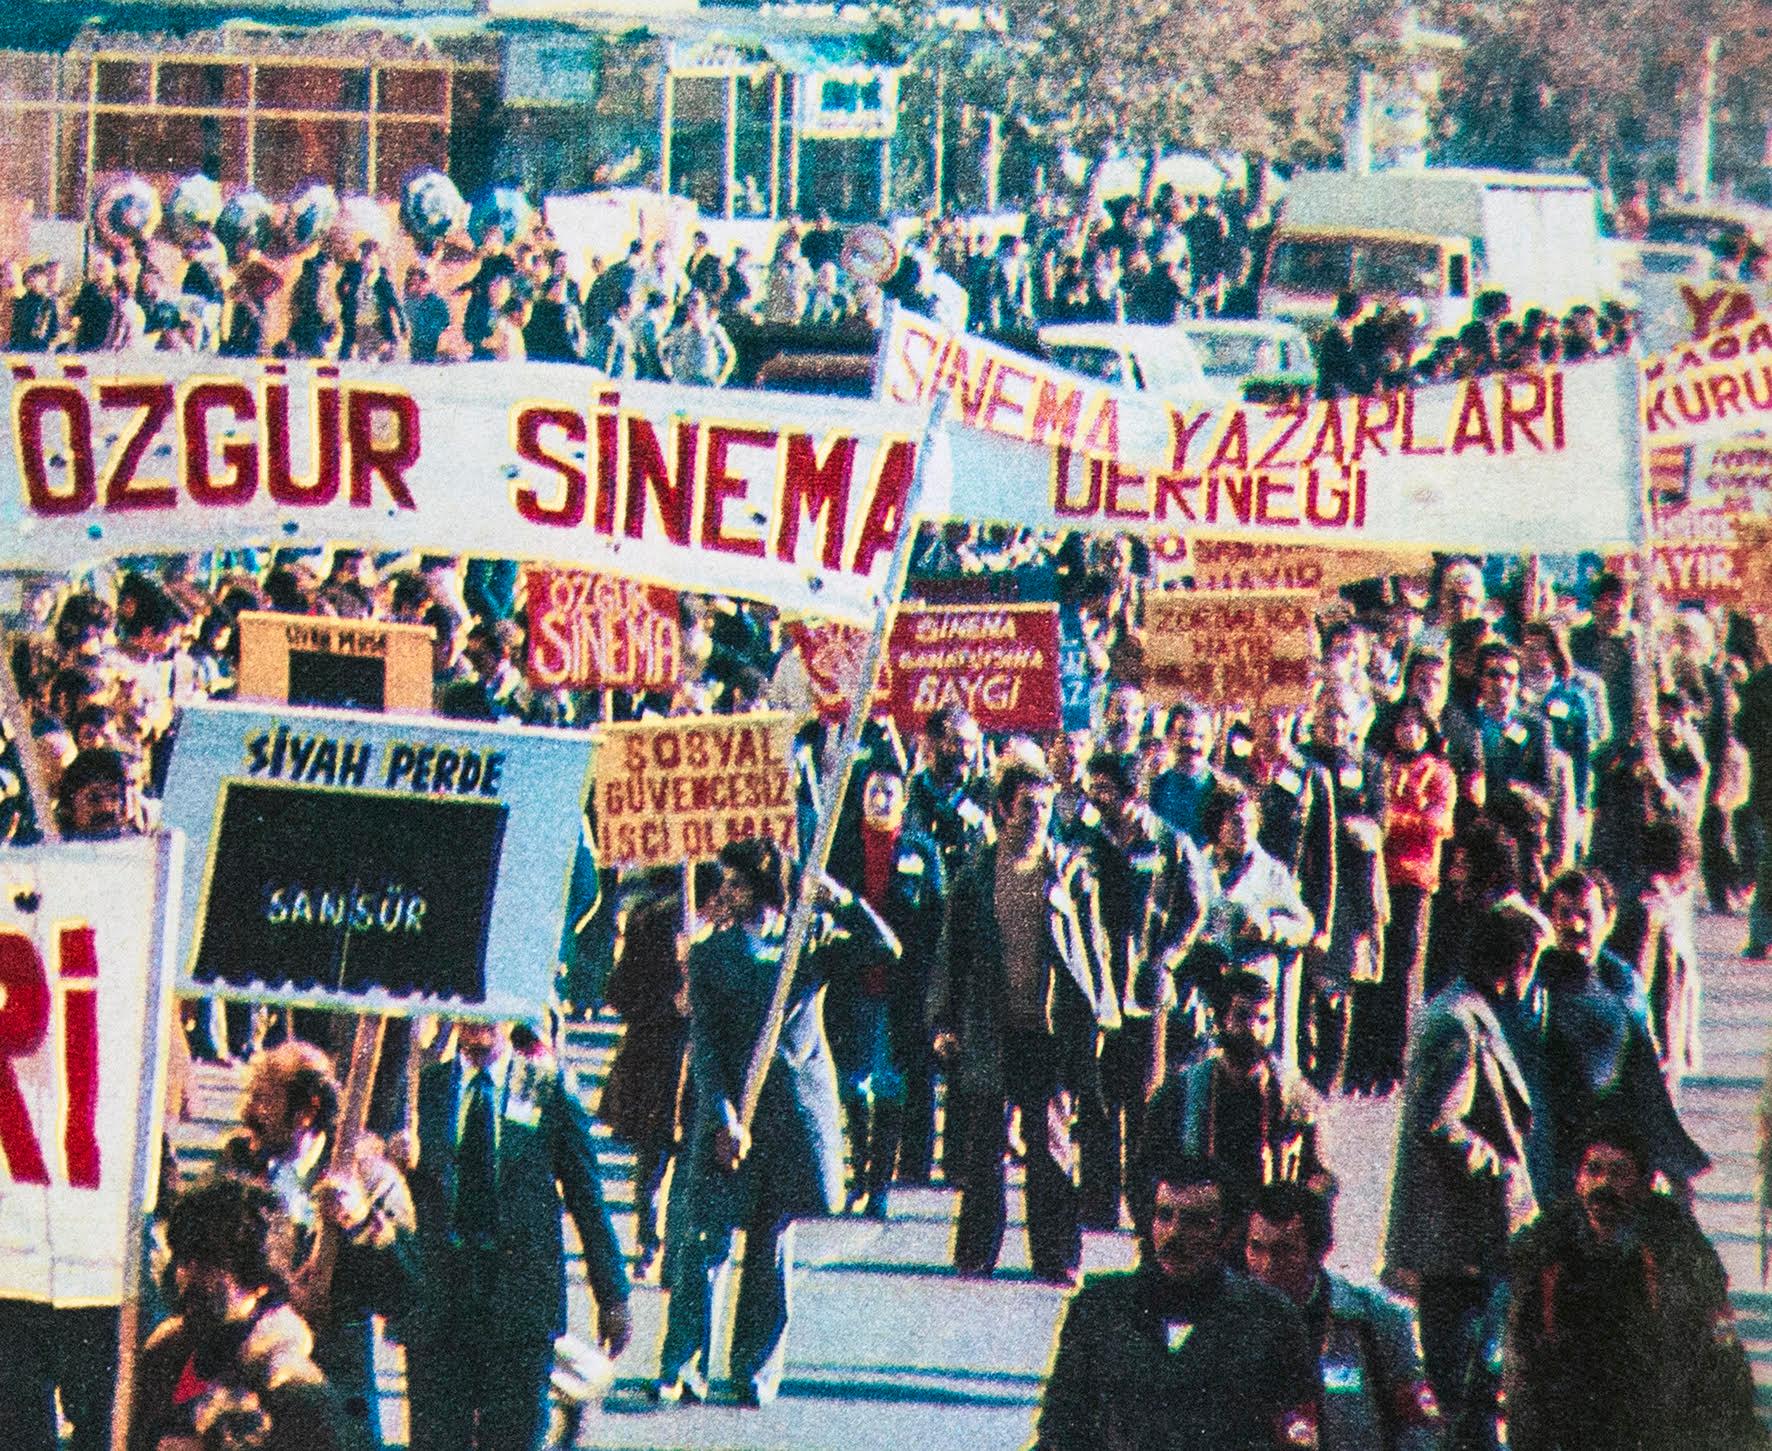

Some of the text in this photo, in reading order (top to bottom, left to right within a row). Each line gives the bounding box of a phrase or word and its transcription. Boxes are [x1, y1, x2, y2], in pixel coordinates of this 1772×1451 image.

[1170, 372, 1566, 472] YAZARLARI
[13, 365, 918, 577] ÖZGÜR SİNEMA
[246, 724, 506, 796] SİYAH PERDE
[624, 726, 784, 771] SOSYAL
[266, 884, 428, 934] SANSÜR
